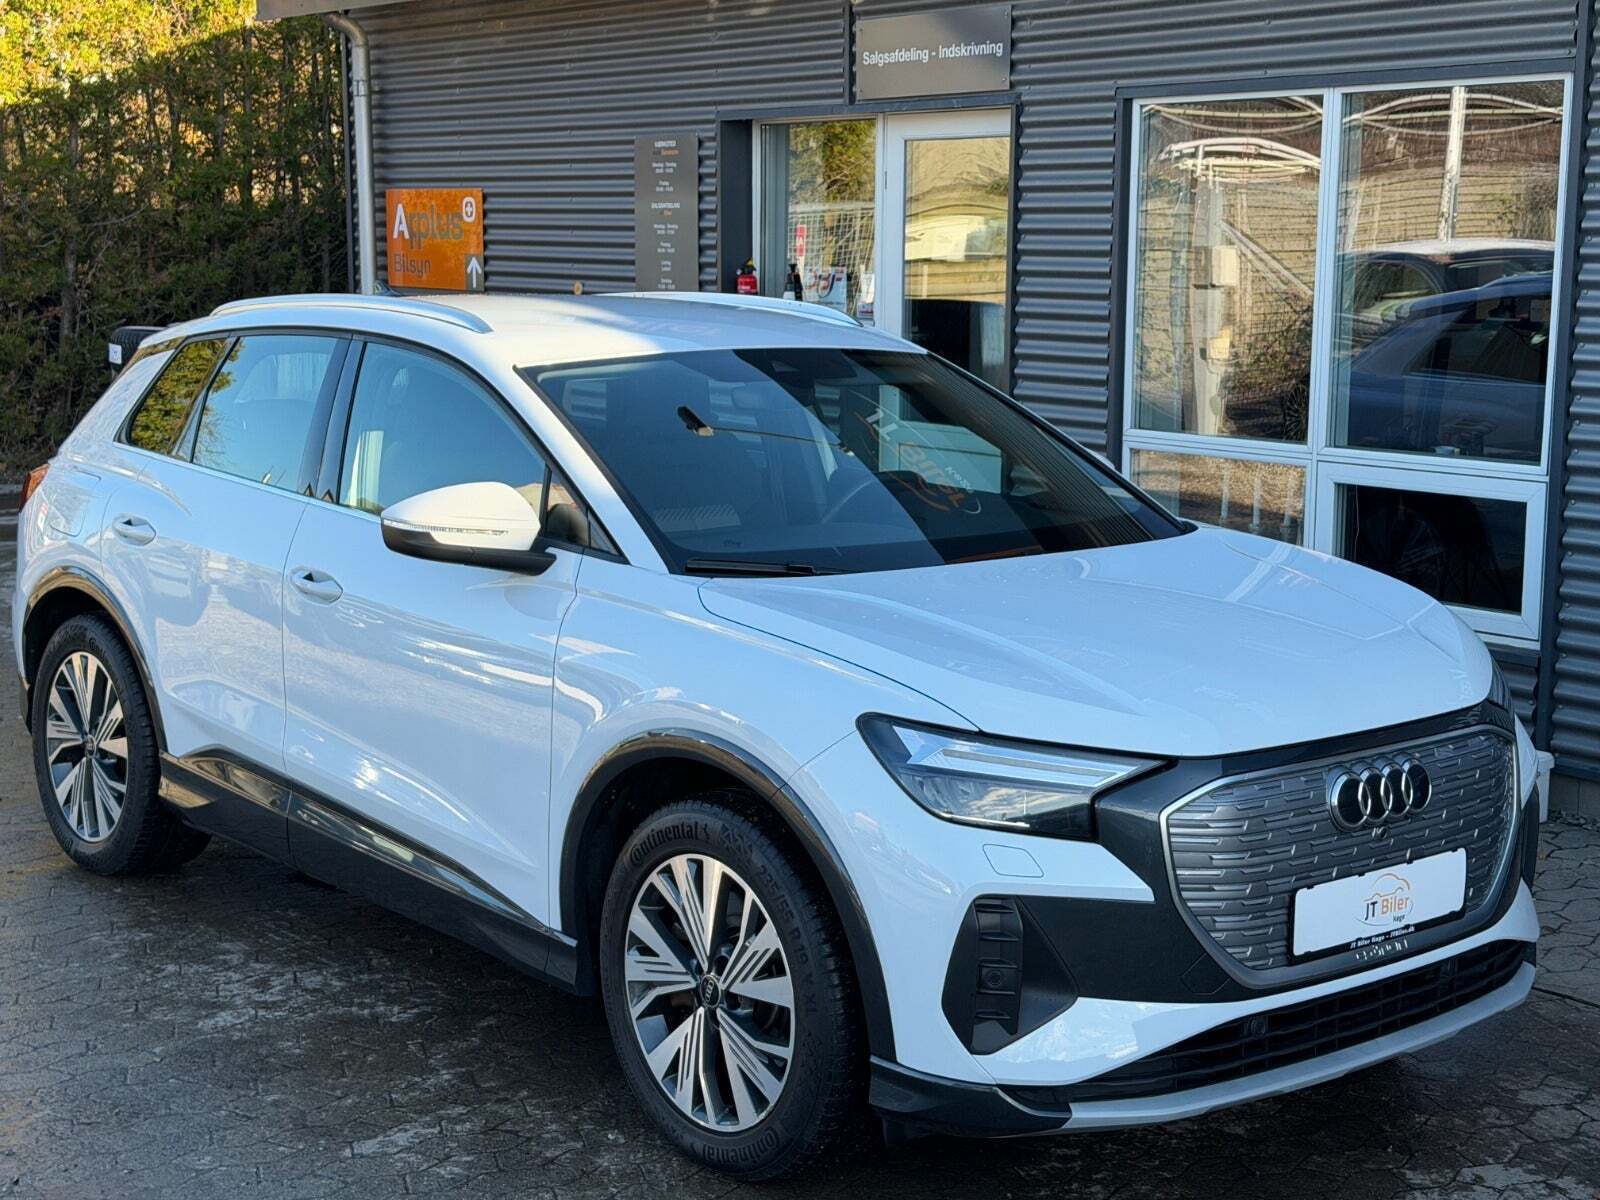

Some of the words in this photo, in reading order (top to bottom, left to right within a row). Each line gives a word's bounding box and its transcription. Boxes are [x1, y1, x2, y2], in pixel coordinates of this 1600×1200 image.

[863, 47, 929, 66] Salgsafdeling
[939, 40, 1003, 59] Indskrivning
[393, 253, 432, 278] Bilsyn
[630, 821, 700, 863] Continental
[1365, 900, 1378, 921] JT
[1380, 895, 1409, 915] Biler
[701, 1126, 780, 1164] Continental
